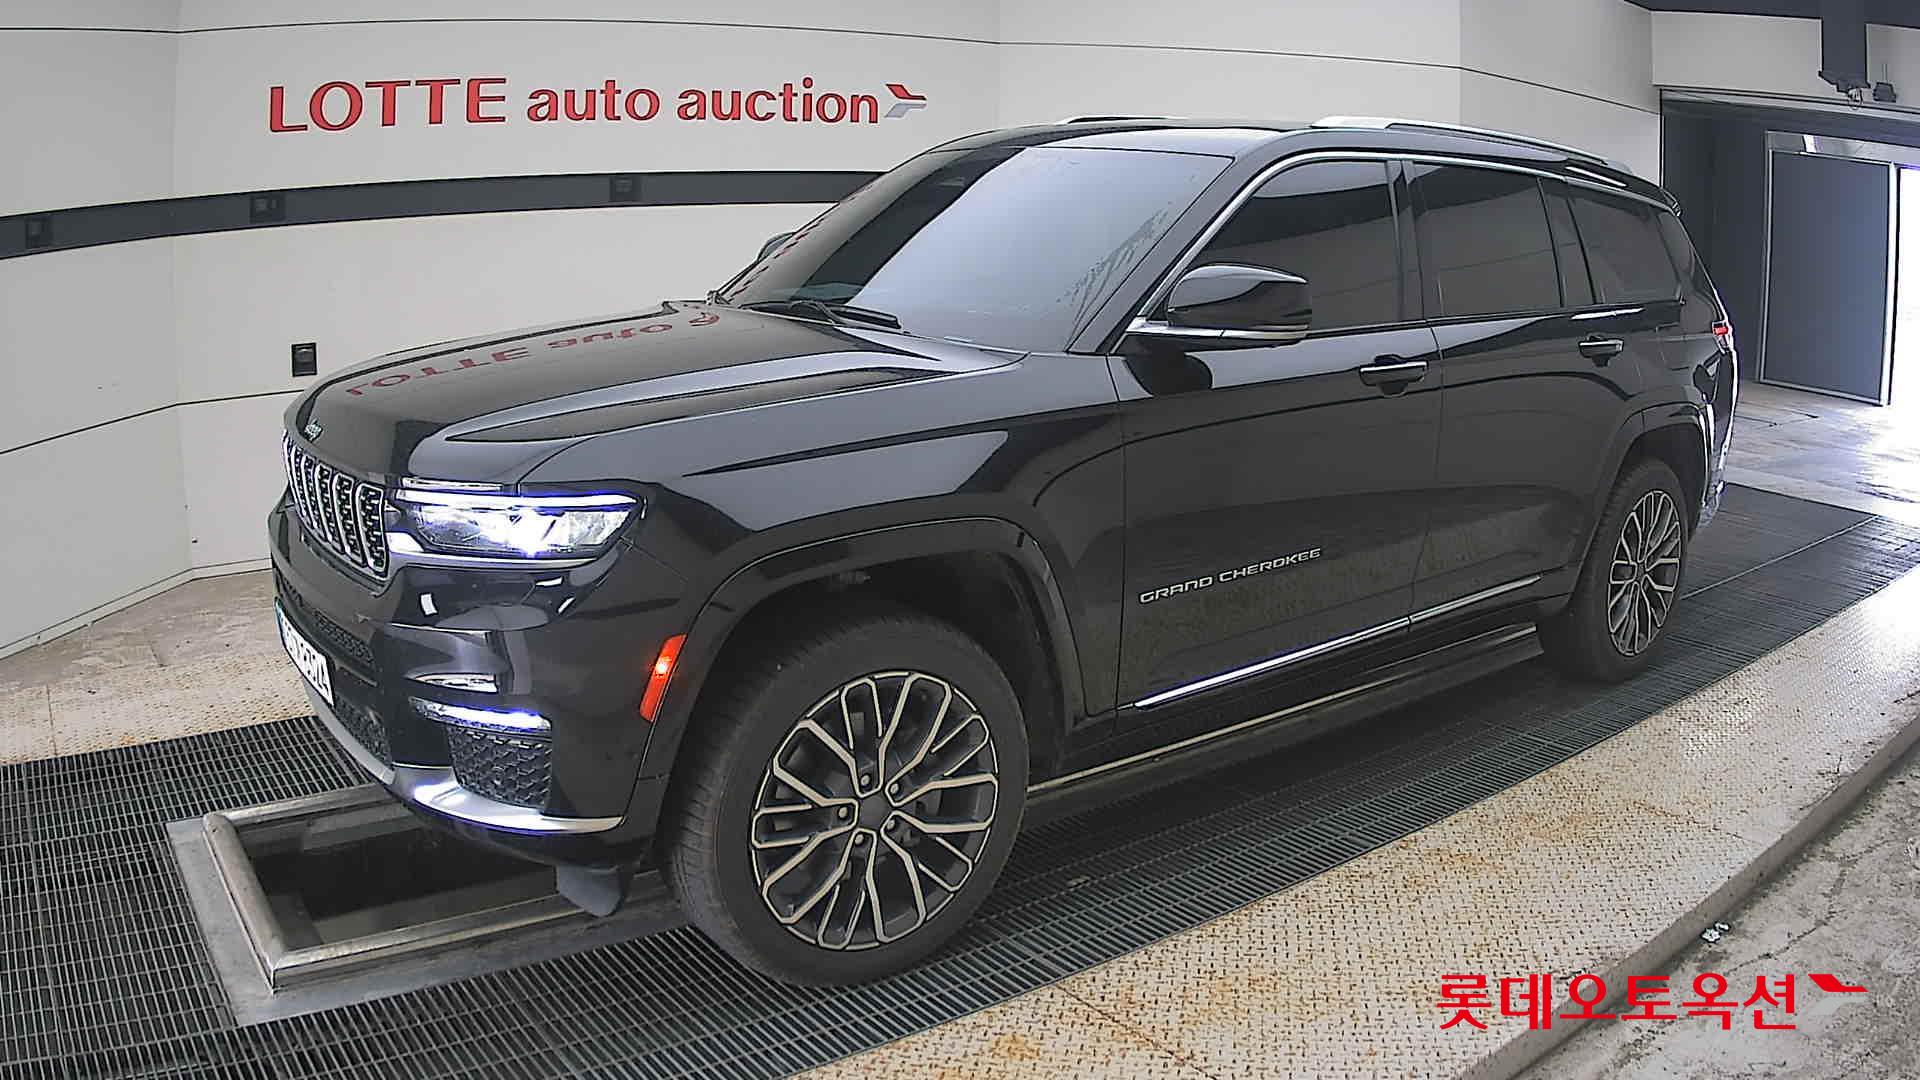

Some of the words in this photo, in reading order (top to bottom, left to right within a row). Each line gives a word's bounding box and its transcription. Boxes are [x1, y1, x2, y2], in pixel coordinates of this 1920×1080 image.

[268, 77, 506, 133] LOTTE
[526, 79, 661, 123] auto
[676, 77, 880, 124] auction
[1139, 576, 1214, 604] GRAND
[1218, 547, 1322, 583] CHEROKEE
